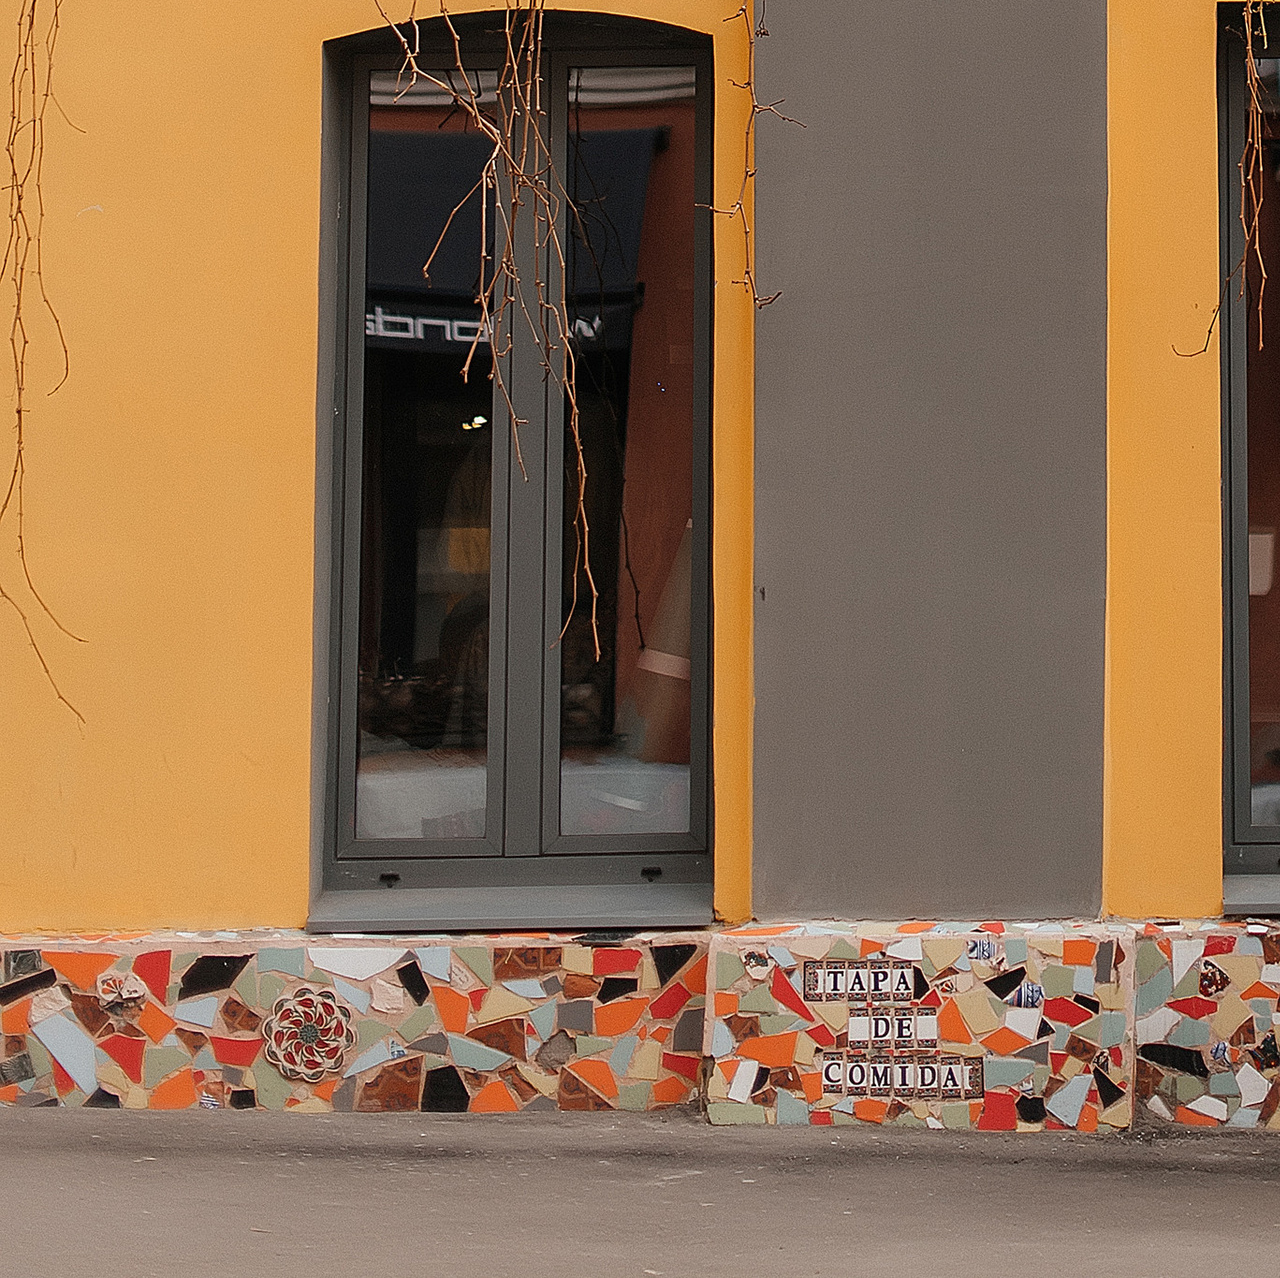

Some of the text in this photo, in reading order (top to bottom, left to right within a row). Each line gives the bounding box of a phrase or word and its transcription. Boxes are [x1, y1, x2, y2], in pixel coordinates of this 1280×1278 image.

[827, 970, 912, 993] TAPA
[872, 1017, 913, 1039] DE
[823, 1062, 960, 1088] COMIDA
